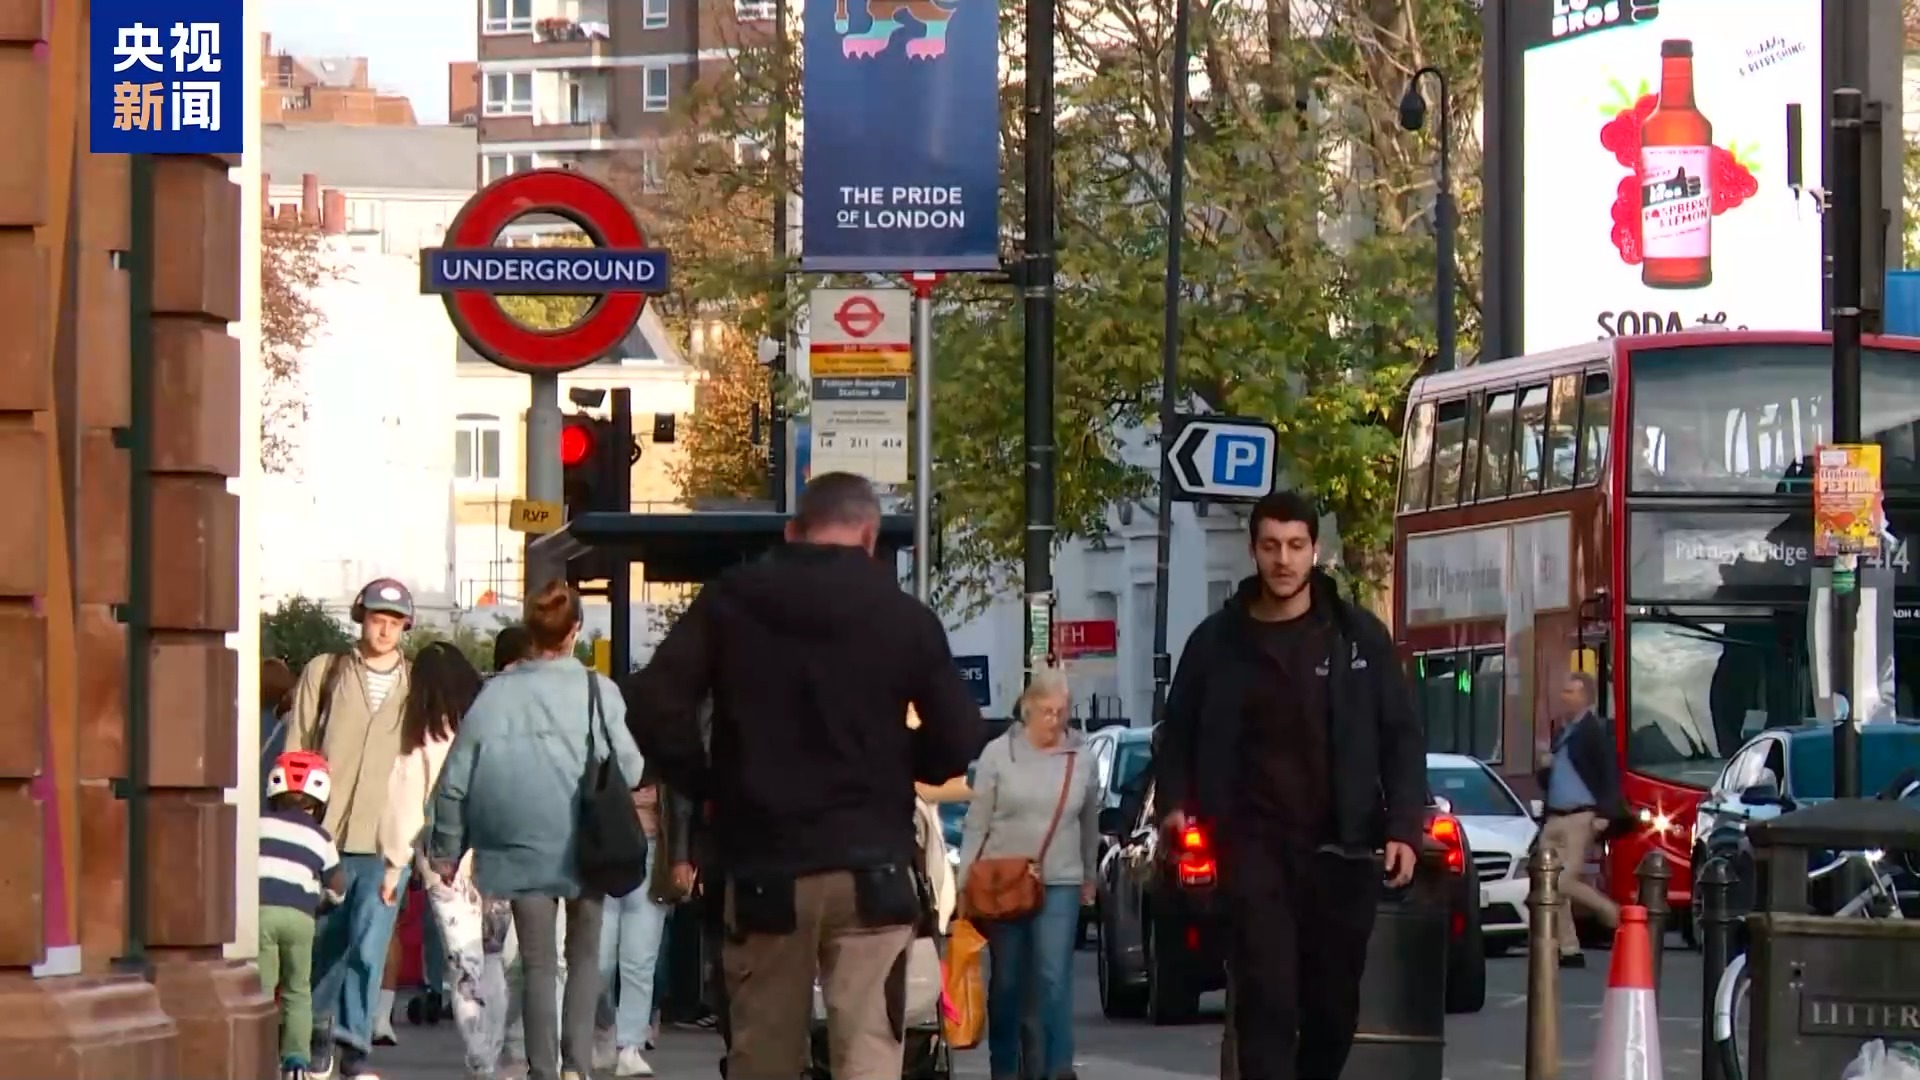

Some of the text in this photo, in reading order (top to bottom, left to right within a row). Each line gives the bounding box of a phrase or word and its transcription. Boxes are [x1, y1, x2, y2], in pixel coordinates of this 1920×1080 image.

[1552, 0, 1620, 38] BROS
[840, 187, 962, 205] THE PRIDE
[836, 210, 965, 228] OF LONDON
[442, 259, 655, 281] UNDERGROUND
[1597, 310, 1684, 341] SODA
[820, 437, 902, 448] 14 211 414
[1225, 440, 1257, 480] P
[522, 509, 549, 523] RVP
[1812, 1002, 1920, 1028] LITTER
